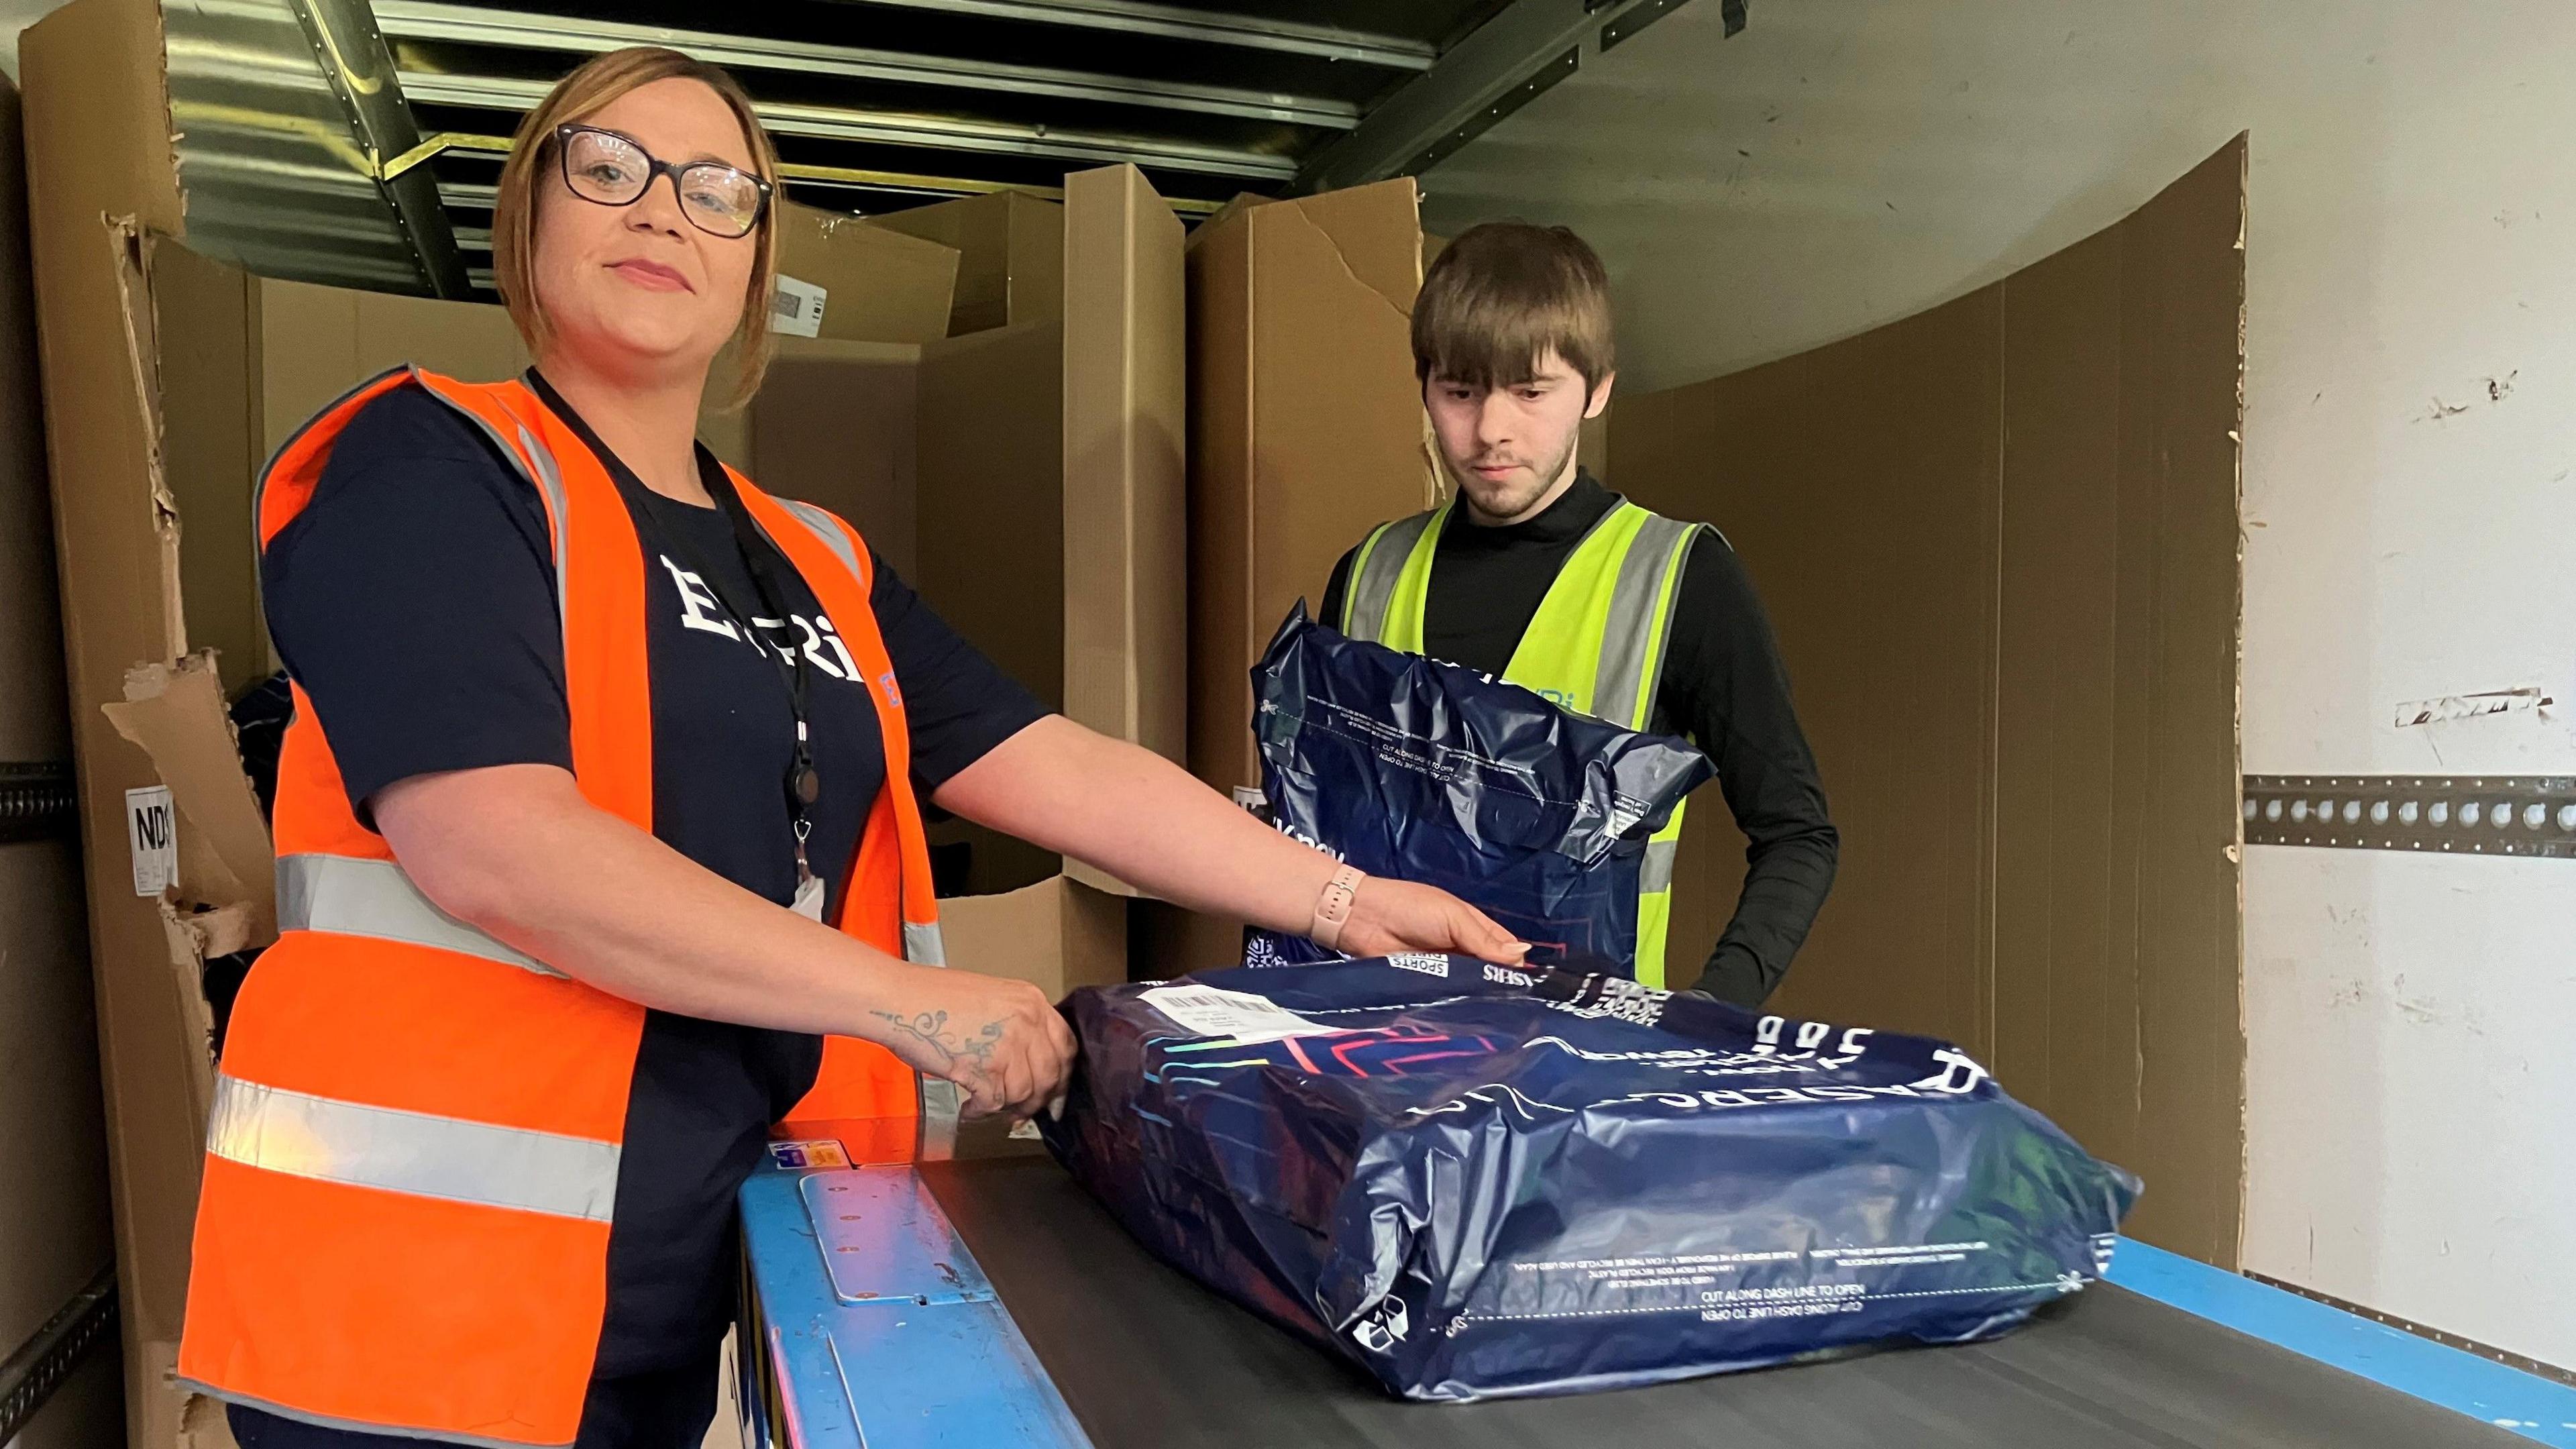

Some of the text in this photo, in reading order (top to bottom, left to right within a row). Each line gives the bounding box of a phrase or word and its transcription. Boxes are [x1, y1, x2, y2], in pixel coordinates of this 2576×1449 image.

[1393, 958, 1444, 973] SPORTS
[1701, 1283, 1866, 1303] CUT ALONG DASH LINE TO OPEN
[1701, 1308, 1732, 1322] OPEN
[1732, 1308, 1748, 1320] TO
[1748, 1307, 1773, 1320] LINE
